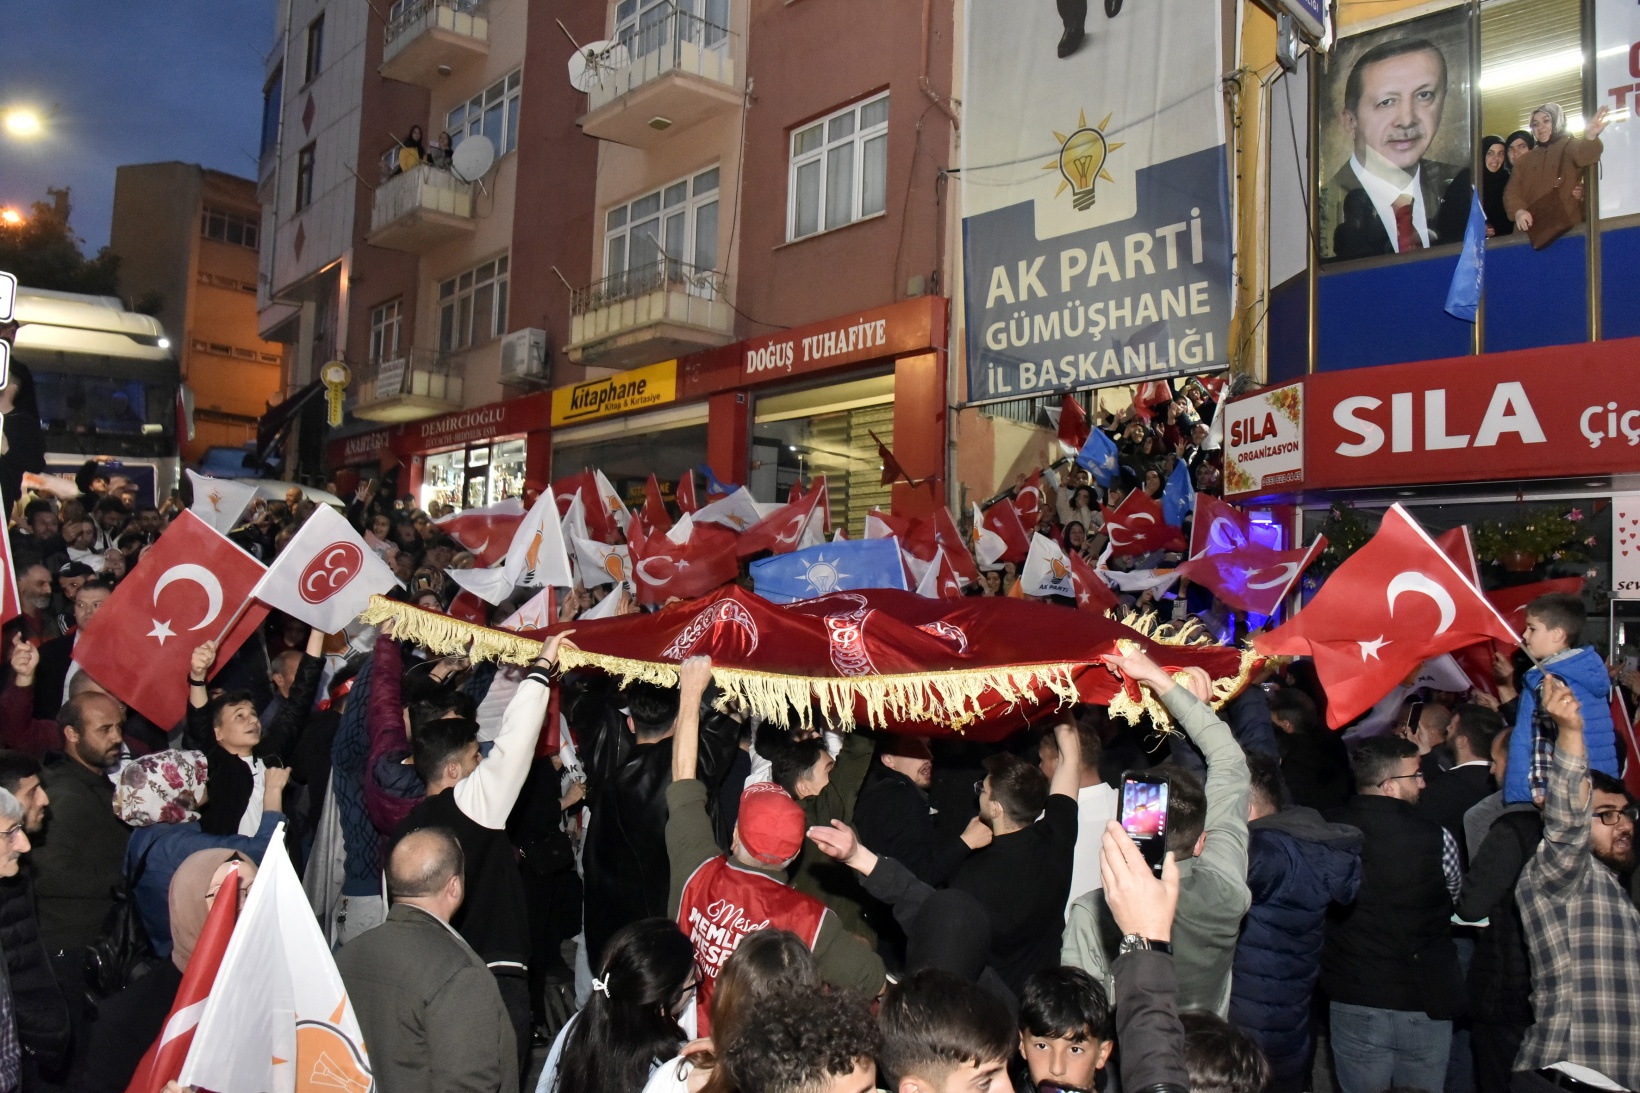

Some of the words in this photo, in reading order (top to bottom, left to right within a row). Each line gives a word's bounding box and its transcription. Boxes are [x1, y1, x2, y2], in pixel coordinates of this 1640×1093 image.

[986, 256, 1047, 309] AK
[1060, 207, 1203, 292] PARTİ
[986, 281, 1211, 351] GÜMÜŞHANE
[746, 341, 794, 374] DOĞUŞ
[802, 317, 886, 362] TUHAFİYE
[988, 363, 1011, 395] İL
[1020, 328, 1215, 390] BAŞKANLIĞI
[571, 379, 646, 410] kitaphane
[605, 402, 621, 412] Kitap
[623, 399, 628, 407] &
[421, 407, 506, 437] DEMİRCİOĞLU
[1231, 412, 1277, 447] SILA
[1333, 382, 1548, 457] SILA
[1238, 441, 1299, 463] ORGANİZASYON
